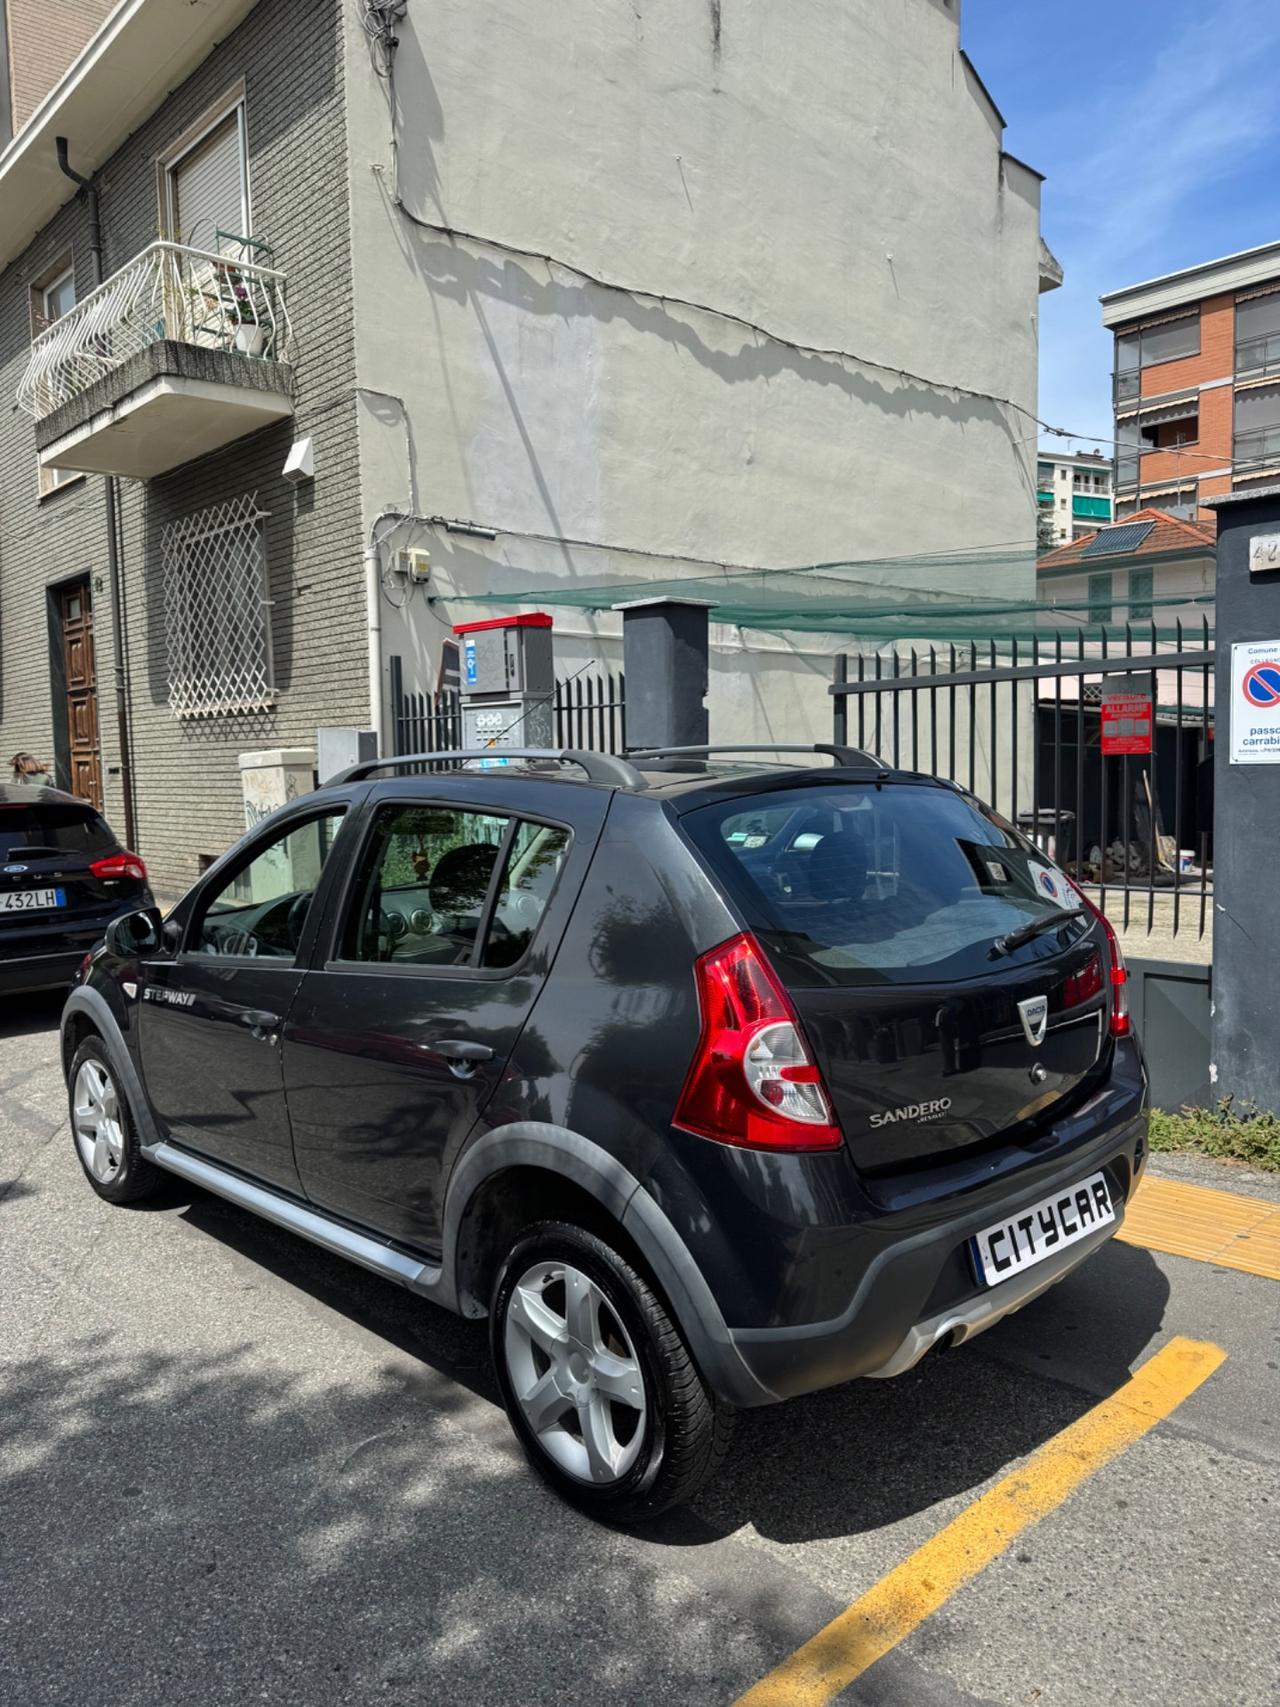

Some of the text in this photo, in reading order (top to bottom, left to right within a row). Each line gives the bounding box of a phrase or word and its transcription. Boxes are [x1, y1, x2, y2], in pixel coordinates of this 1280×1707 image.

[1248, 647, 1279, 655] Comune
[5, 890, 55, 910] 432LH
[144, 988, 190, 1005] STEPWAY
[1027, 1004, 1046, 1017] DACIA
[869, 1097, 952, 1128] SANDERO
[988, 1180, 1112, 1273] CITYCAR
